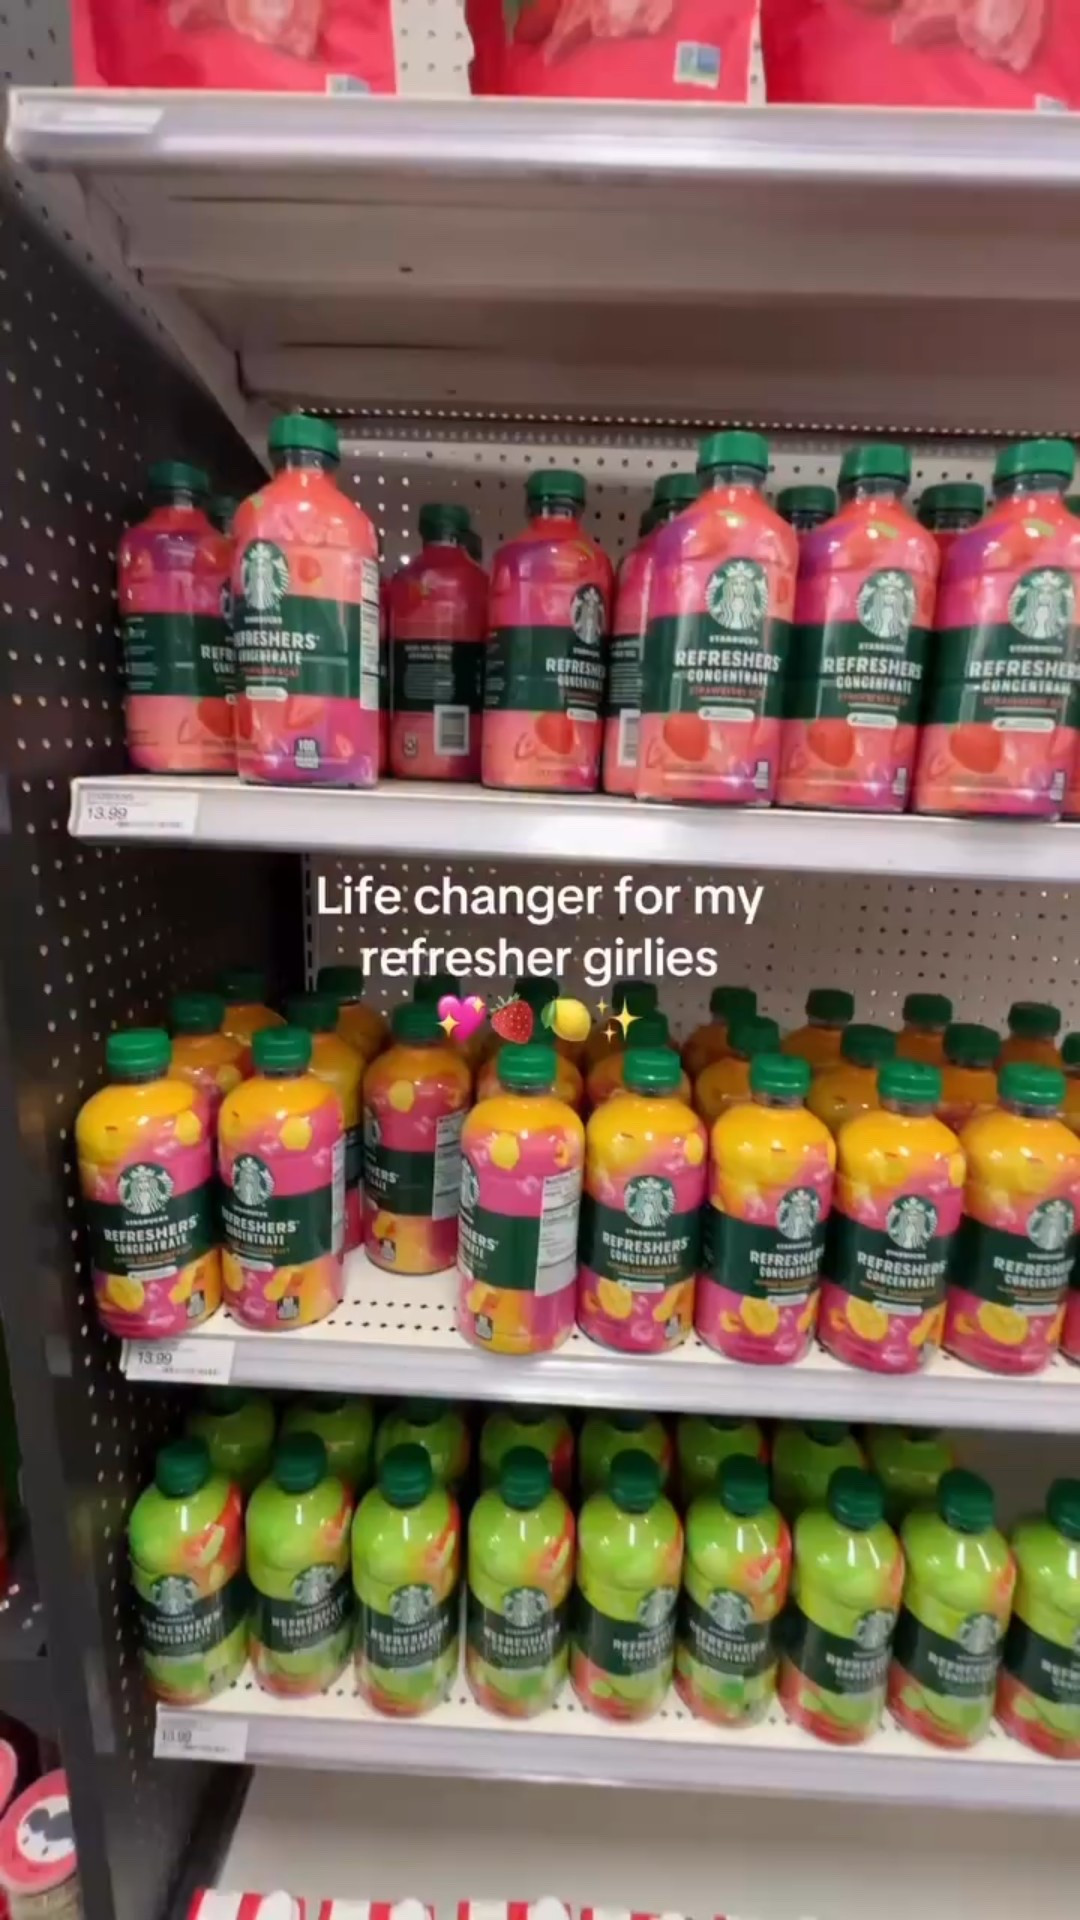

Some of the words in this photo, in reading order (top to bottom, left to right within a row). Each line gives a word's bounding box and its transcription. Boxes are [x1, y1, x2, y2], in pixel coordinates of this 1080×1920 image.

[674, 649, 781, 672] REFRESHERS
[103, 1214, 198, 1242] REFRESHERS
[602, 1231, 689, 1254] REFRESHERS
